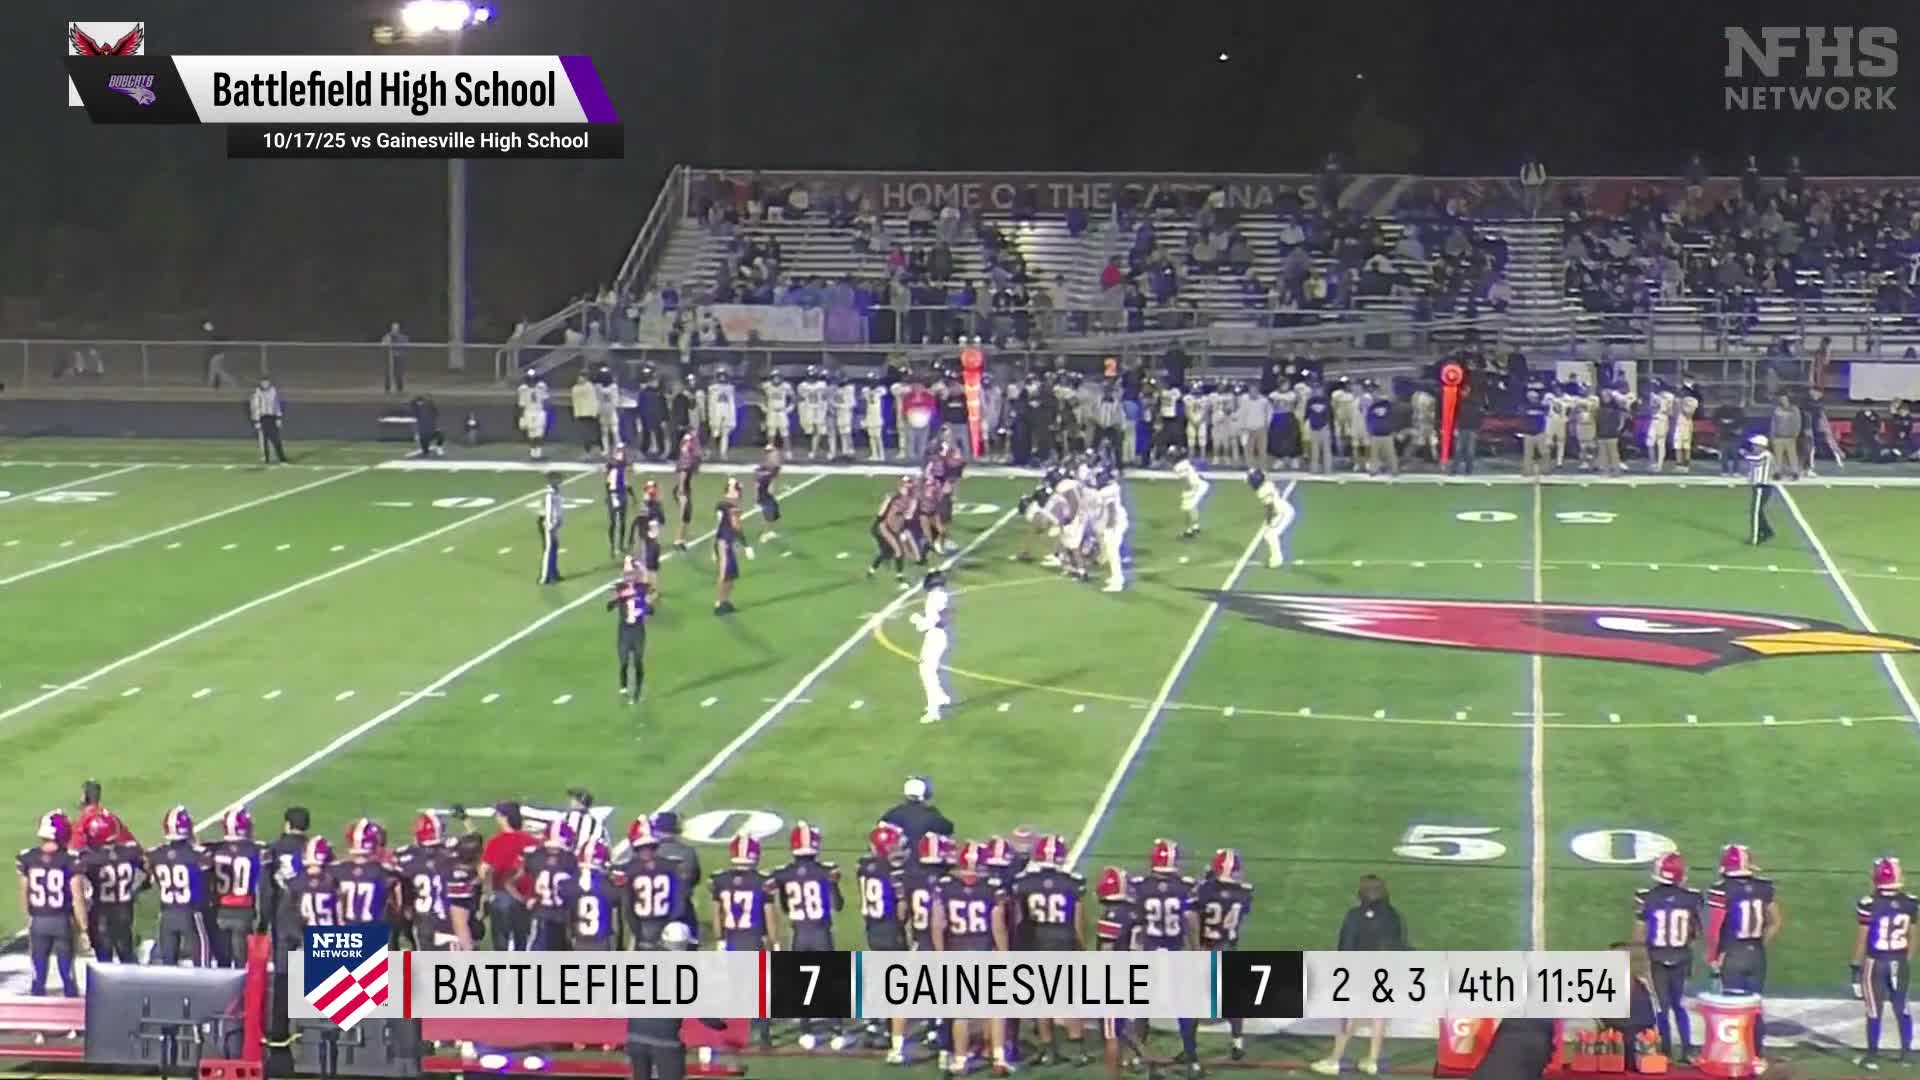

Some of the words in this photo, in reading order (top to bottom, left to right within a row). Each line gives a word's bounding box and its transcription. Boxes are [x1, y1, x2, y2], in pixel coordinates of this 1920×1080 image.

[883, 183, 983, 209] HOME
[1048, 183, 1112, 208] THE
[28, 867, 65, 908] 59
[99, 862, 134, 903] 22
[155, 863, 192, 904] 29
[213, 854, 252, 897] 50
[633, 874, 671, 918] 32
[301, 891, 333, 926] 45
[340, 881, 376, 922] 77
[719, 889, 754, 930] 17
[784, 880, 824, 921] 28
[860, 875, 885, 919] 19
[949, 900, 988, 934] 56
[1144, 898, 1183, 937] 26
[1203, 902, 1243, 940] 24
[1653, 908, 1691, 948] 10
[1735, 898, 1765, 939] 11
[1874, 913, 1910, 951] 12
[1717, 1017, 1744, 1042] G
